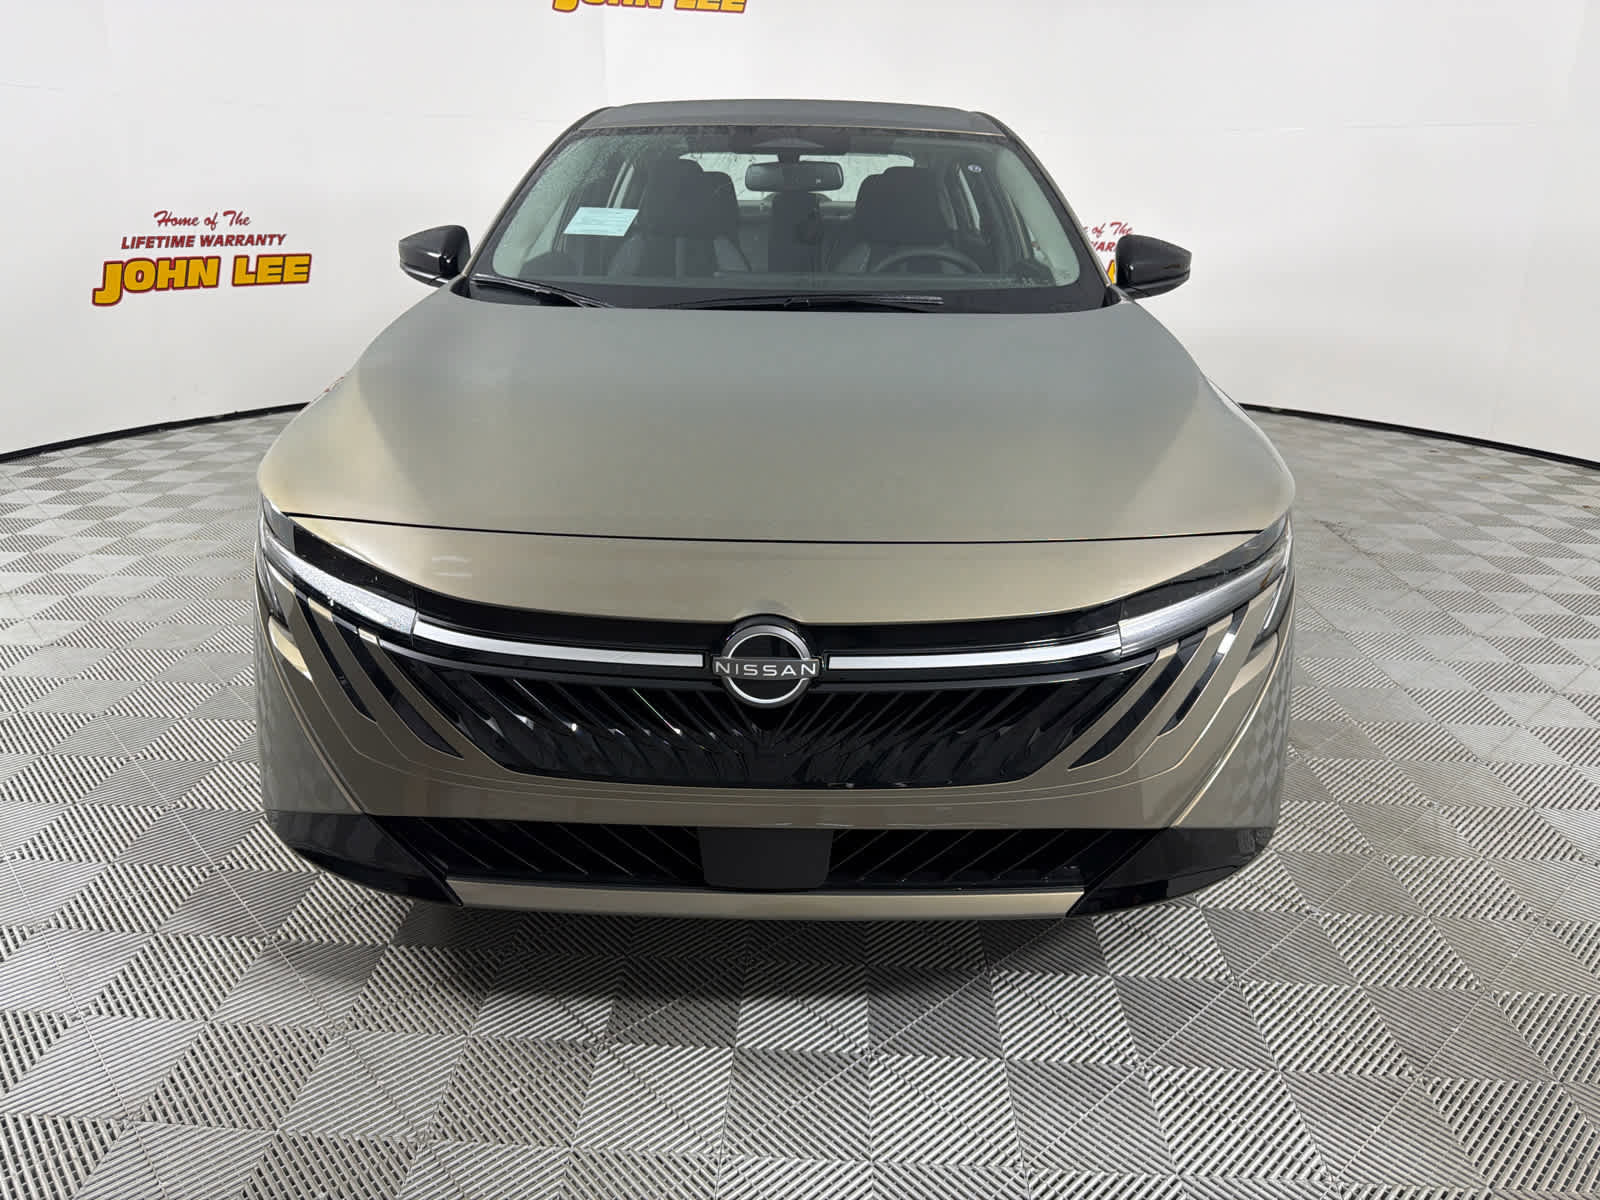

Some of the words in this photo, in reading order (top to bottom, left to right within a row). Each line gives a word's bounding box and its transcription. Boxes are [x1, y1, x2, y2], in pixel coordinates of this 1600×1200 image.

[153, 210, 200, 228] Home
[203, 212, 218, 231] of
[223, 210, 251, 227] The
[120, 234, 195, 250] LIFETIME
[199, 233, 287, 248] WARRANTY
[92, 256, 221, 307] JOHN
[231, 253, 312, 287] LEE
[715, 661, 816, 677] NISSAN
